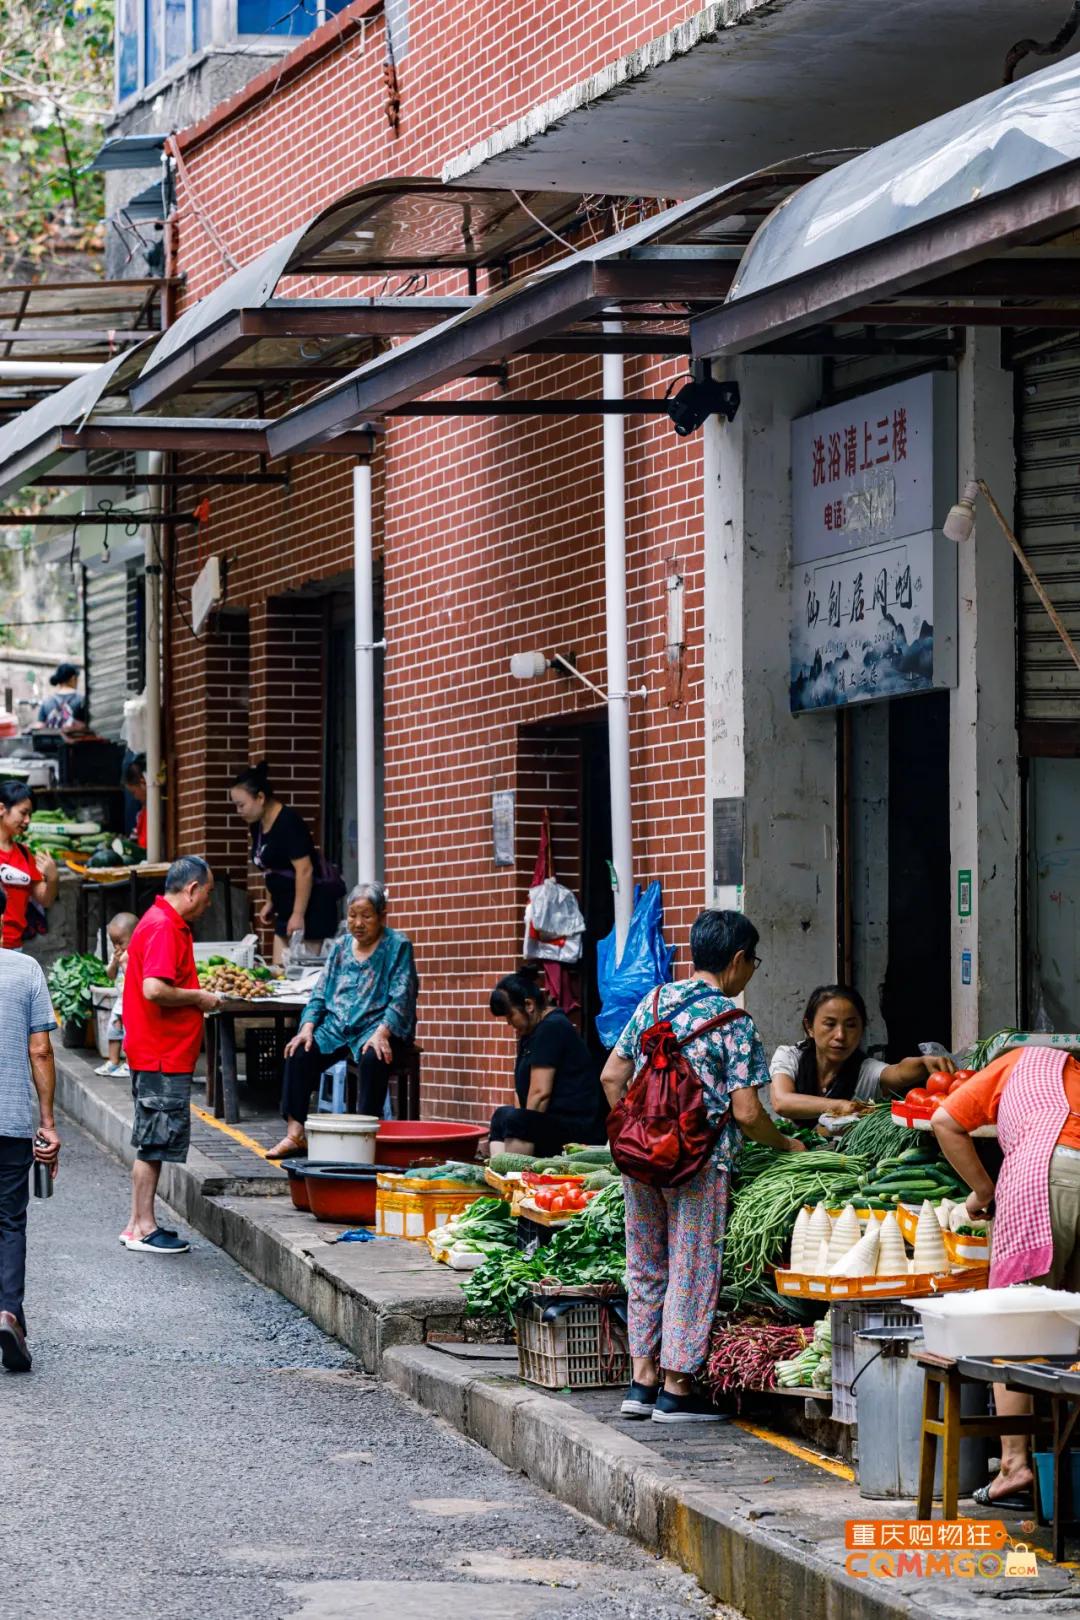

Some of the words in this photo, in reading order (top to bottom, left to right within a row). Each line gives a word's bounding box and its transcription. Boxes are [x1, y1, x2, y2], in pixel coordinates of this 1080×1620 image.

[812, 408, 907, 487] 洗浴请上三楼
